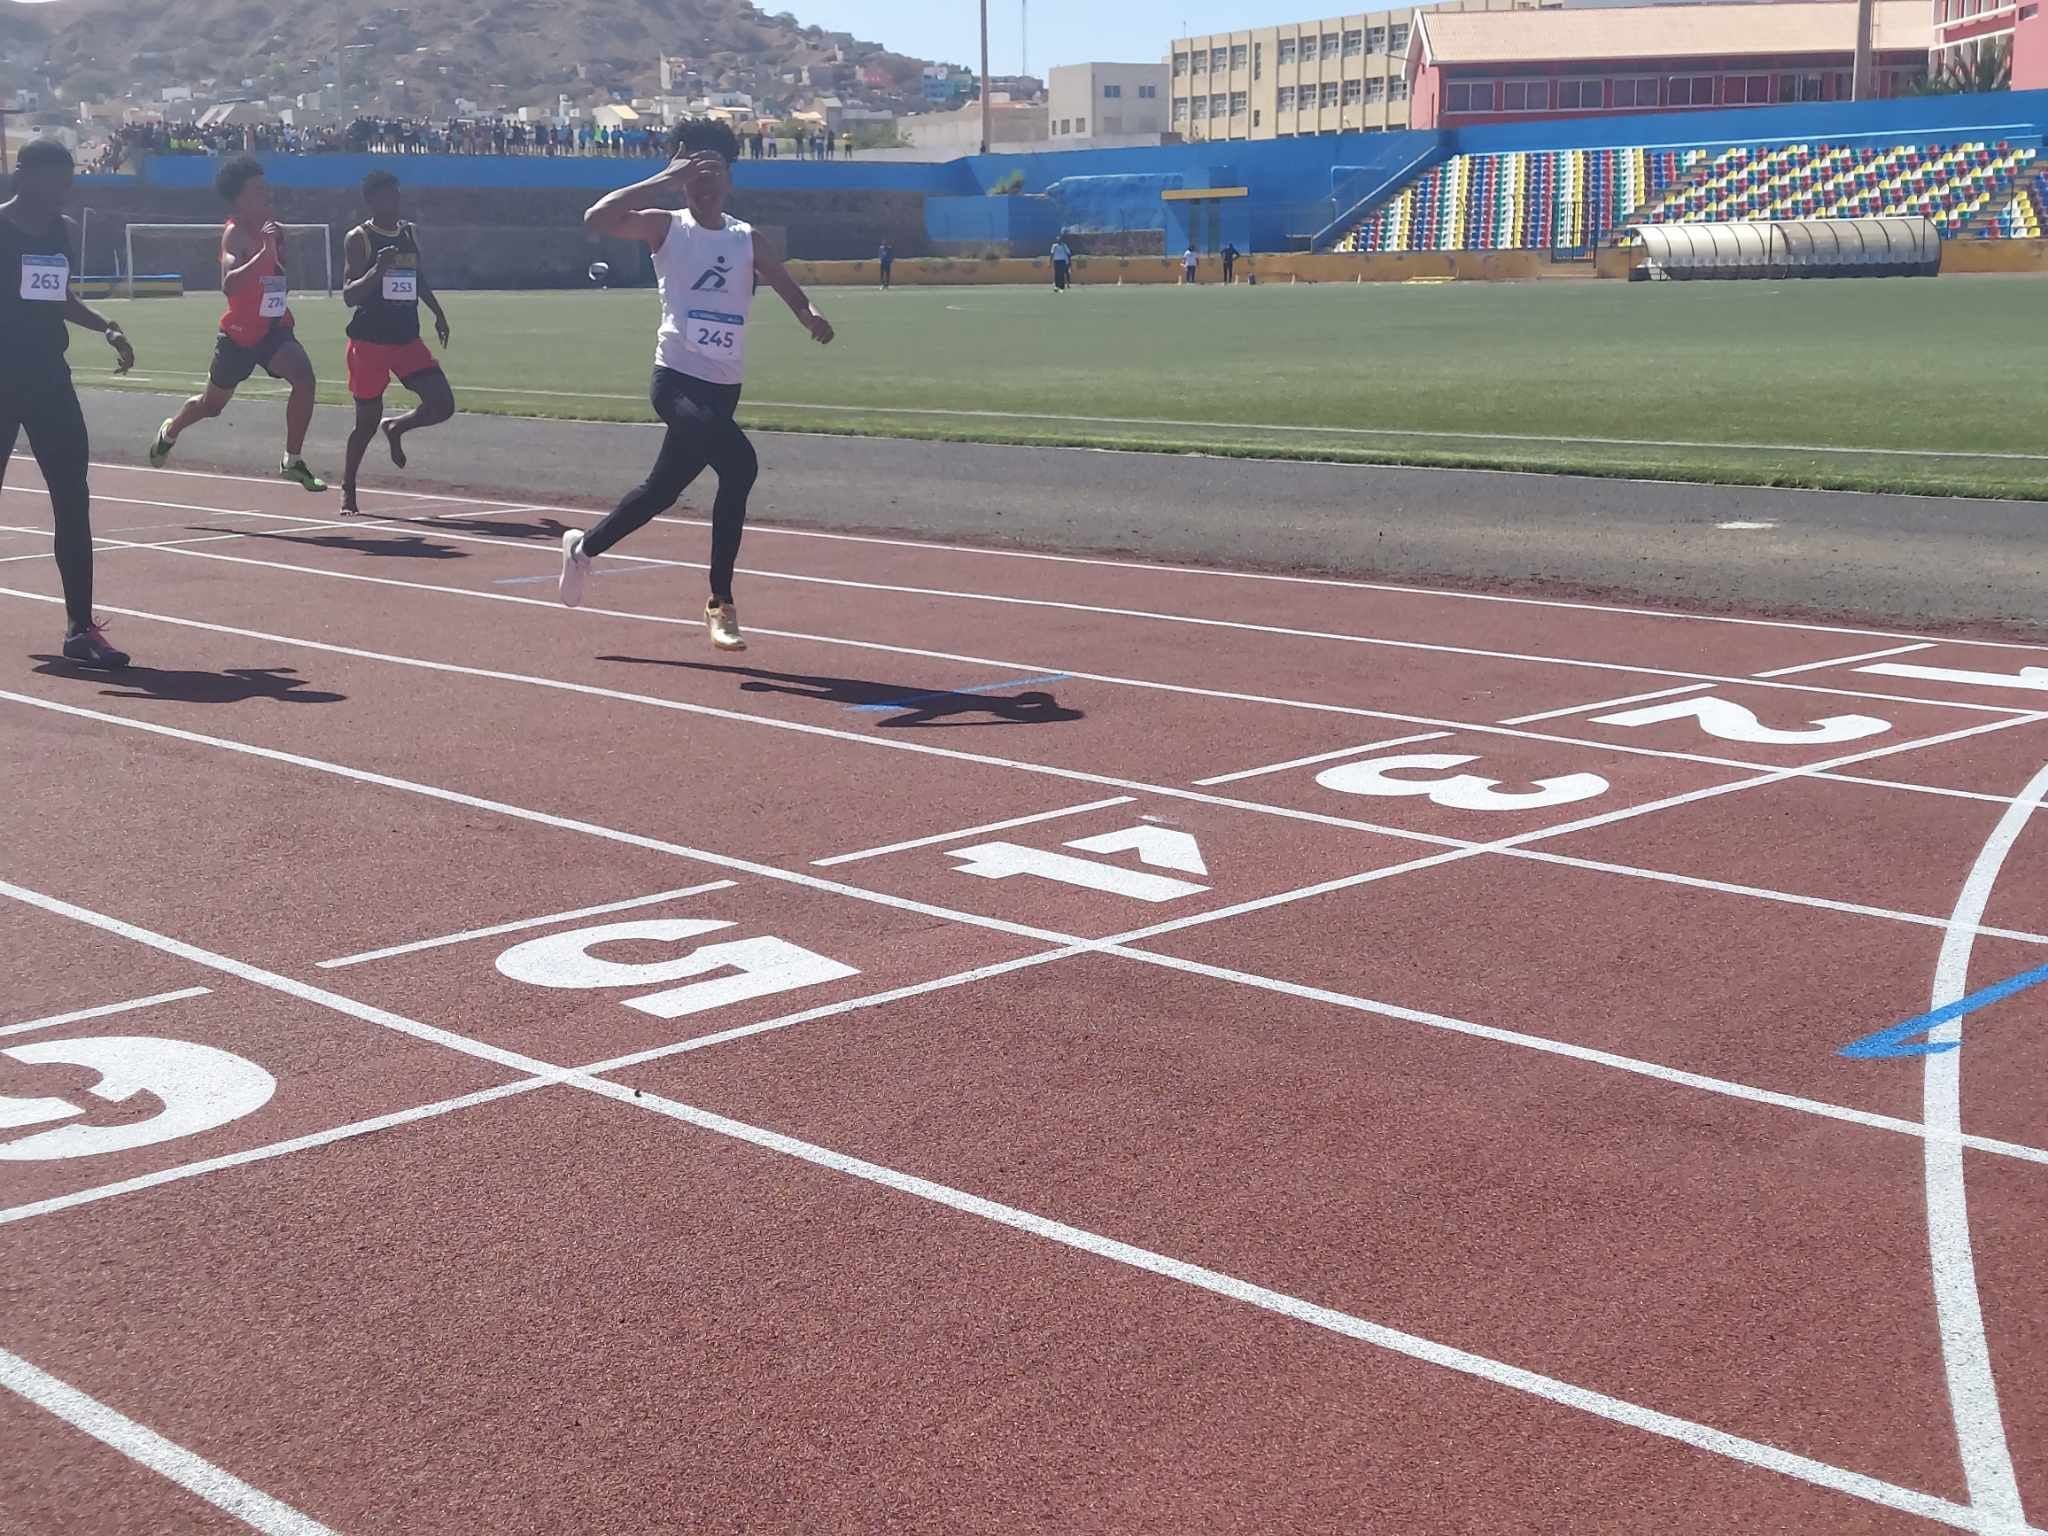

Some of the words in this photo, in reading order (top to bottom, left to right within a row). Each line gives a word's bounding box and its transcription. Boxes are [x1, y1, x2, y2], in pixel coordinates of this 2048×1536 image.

[31, 272, 60, 291] 263
[697, 327, 735, 349] 245
[1589, 695, 1892, 746] 2
[1315, 753, 1610, 811] 3
[945, 823, 1212, 904] 4
[494, 918, 863, 1020] 5
